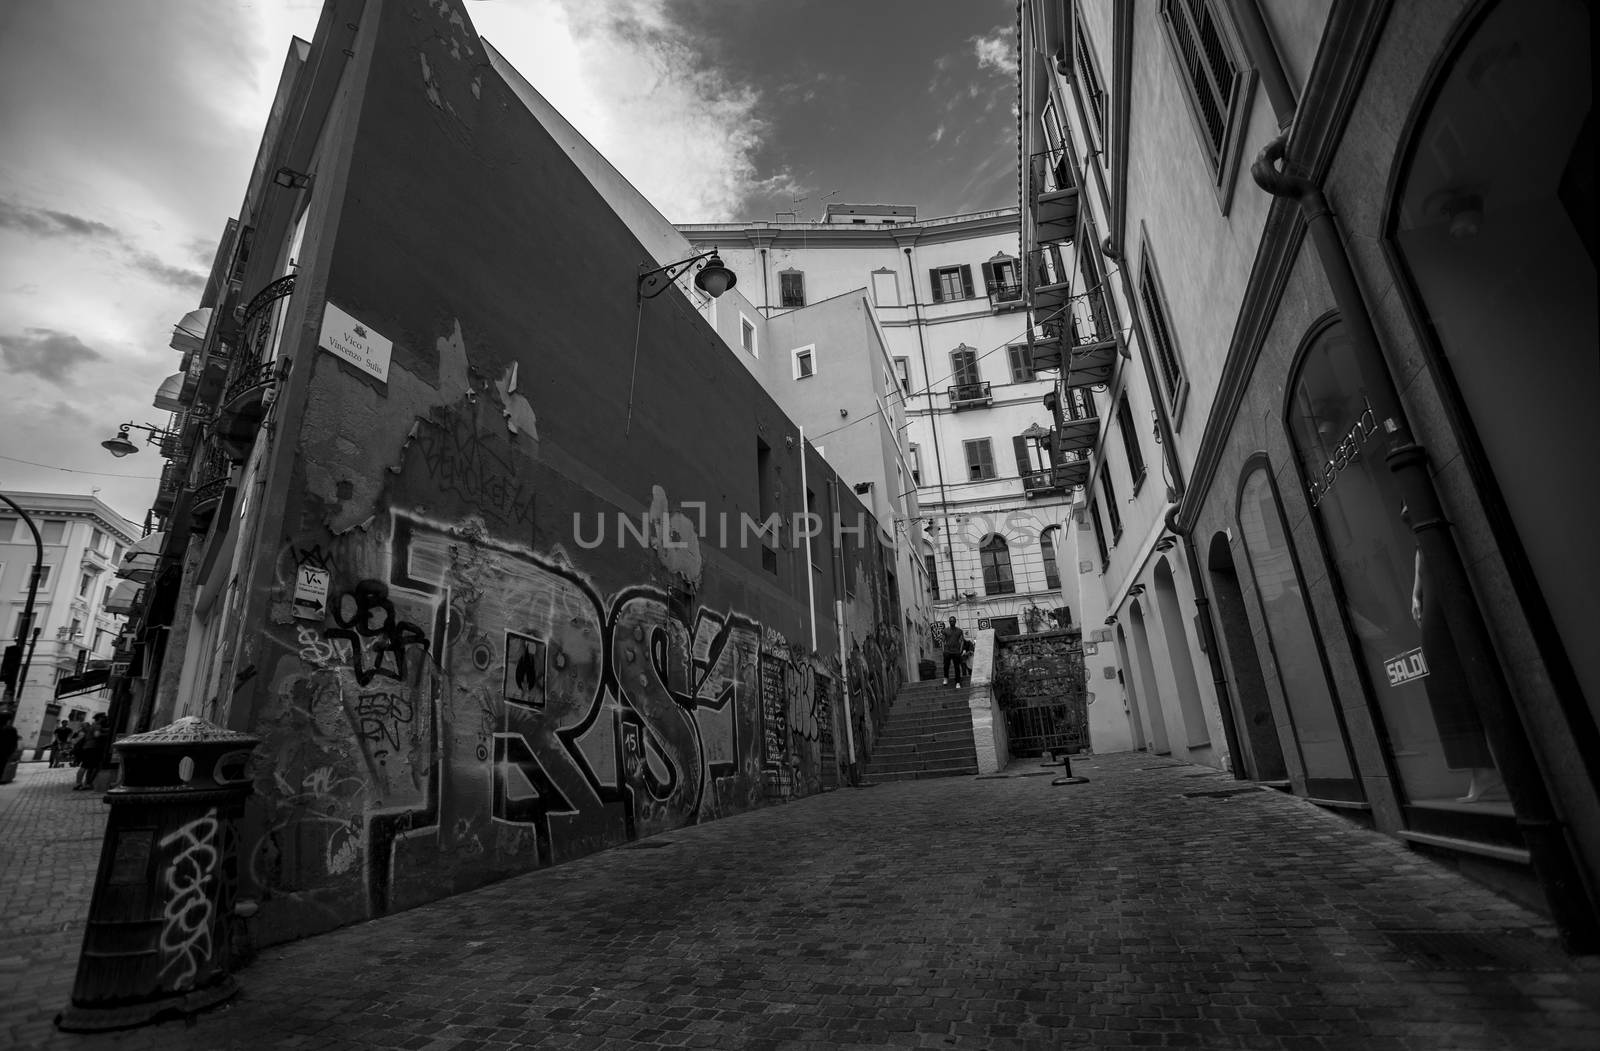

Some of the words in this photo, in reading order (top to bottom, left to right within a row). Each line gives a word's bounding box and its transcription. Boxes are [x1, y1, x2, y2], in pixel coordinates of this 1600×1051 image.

[328, 336, 362, 362] Vincenzo
[366, 358, 383, 375] Sulis
[343, 331, 362, 350] Vico
[1386, 652, 1427, 684] SALDI
